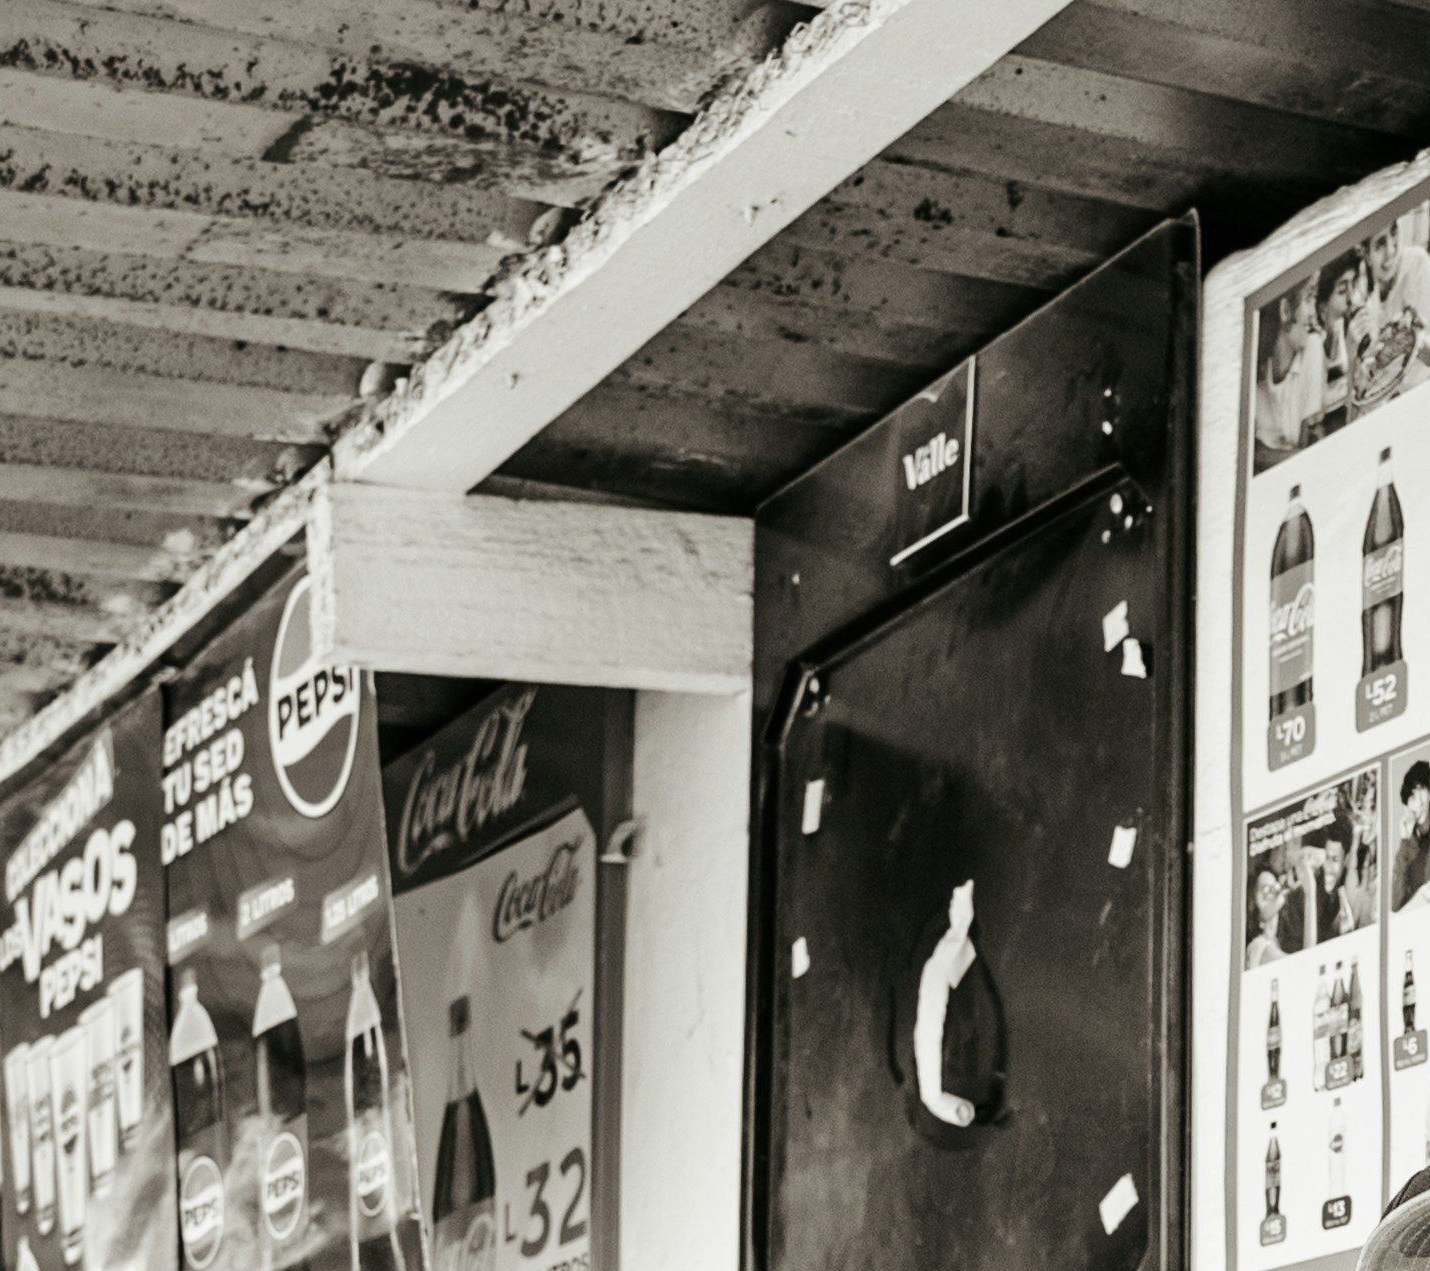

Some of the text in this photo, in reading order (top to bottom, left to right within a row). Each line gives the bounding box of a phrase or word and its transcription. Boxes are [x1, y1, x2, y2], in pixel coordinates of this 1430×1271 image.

[163, 655, 259, 768] EFRESCÁ
[162, 727, 245, 815] TU SED
[161, 772, 254, 866] DE MÁS
[14, 818, 138, 984] VASOS
[39, 932, 104, 1019] PEPSI
